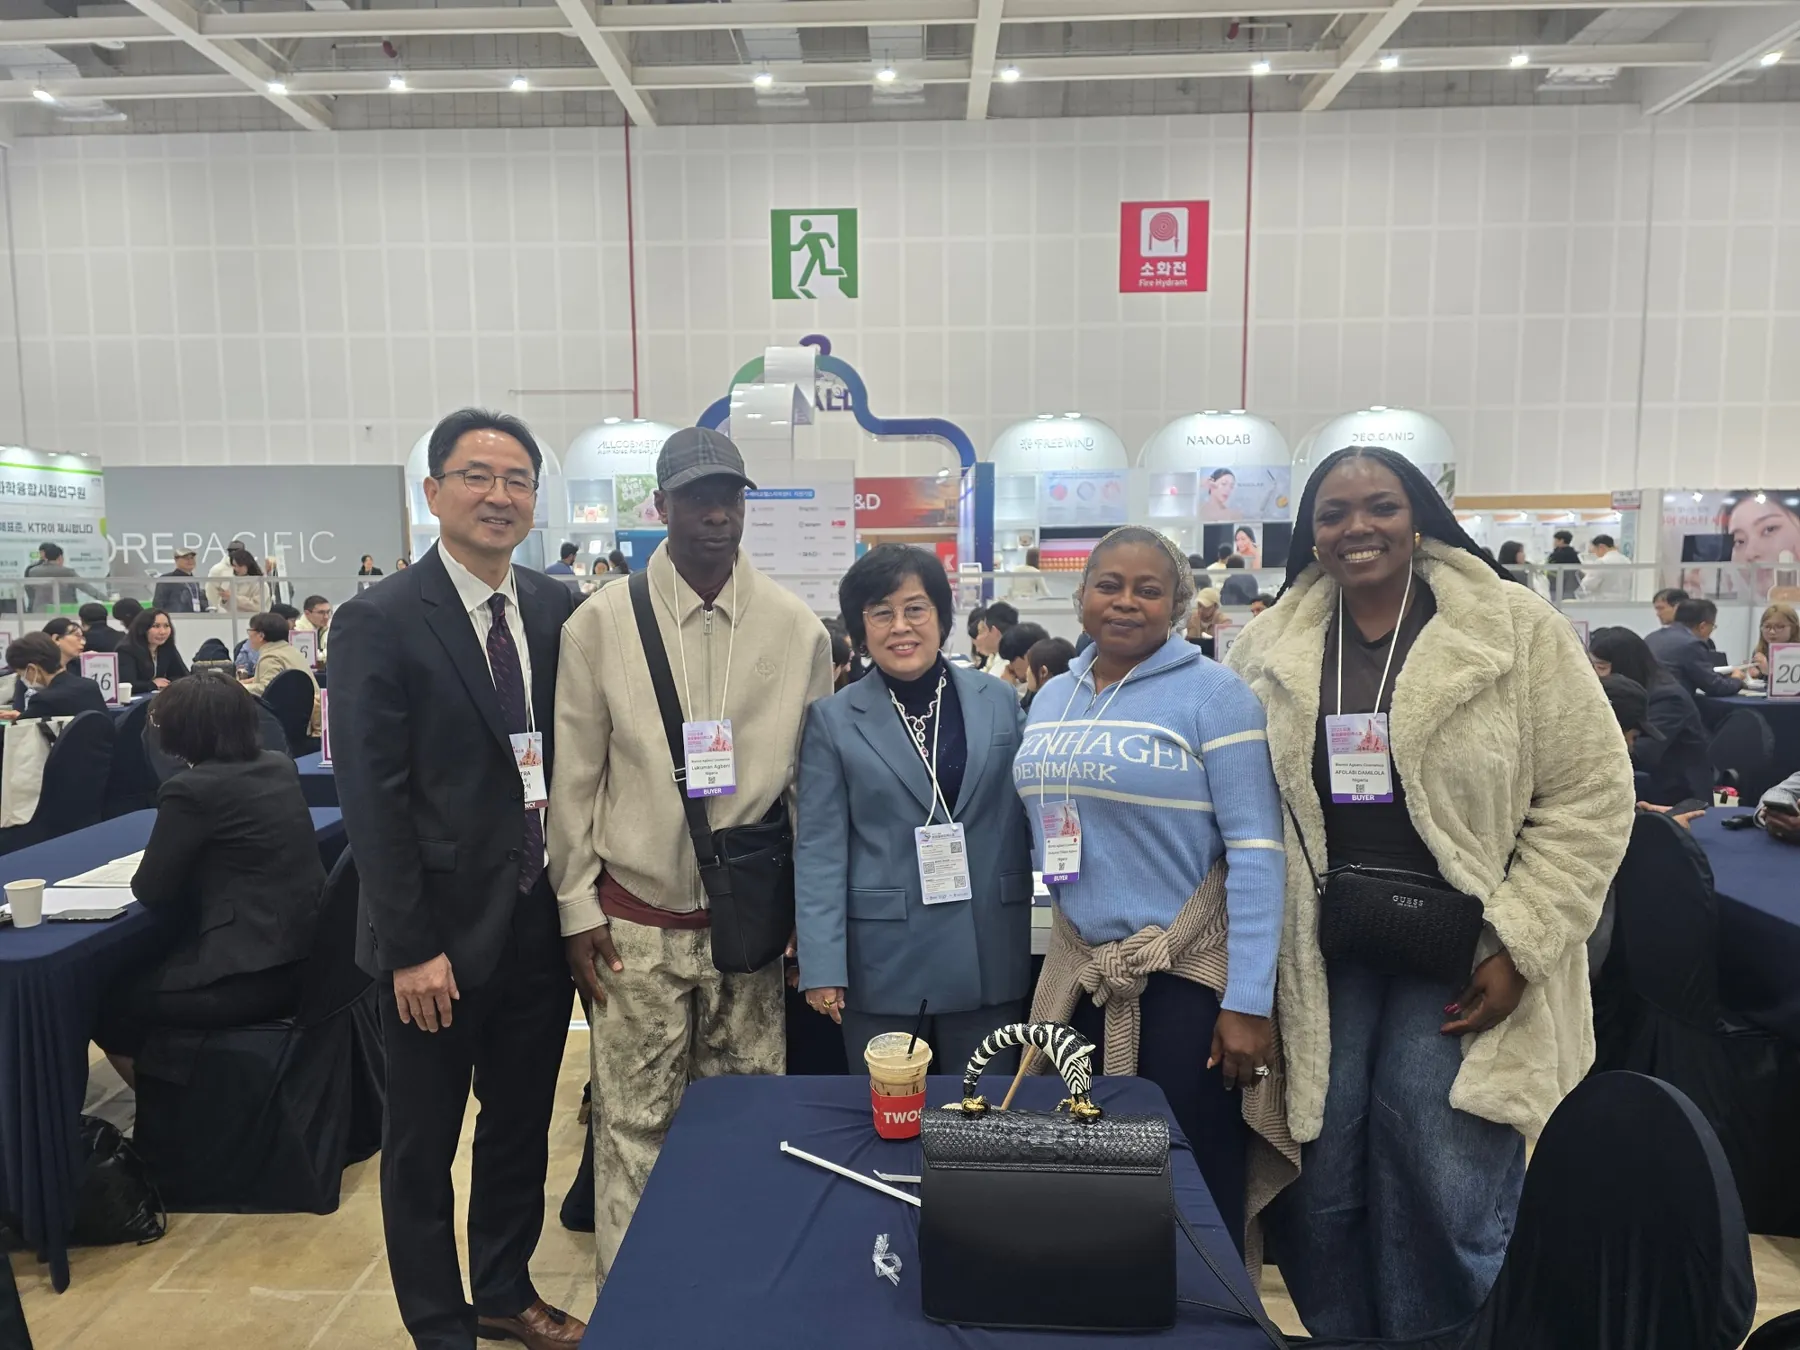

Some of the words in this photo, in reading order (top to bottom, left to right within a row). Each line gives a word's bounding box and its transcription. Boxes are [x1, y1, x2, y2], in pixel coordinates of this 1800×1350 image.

[1140, 260, 1187, 276] 소화전
[1138, 278, 1154, 287] Fire
[1155, 277, 1188, 288] Hydrant
[1186, 434, 1251, 446] NANOLAB
[28, 522, 55, 534] KTR이
[57, 522, 94, 534] 제시합니다
[1775, 663, 1800, 684] 20
[1013, 761, 1118, 783] DENMARK
[703, 787, 722, 795] BUYER
[1392, 895, 1424, 907] GUESS
